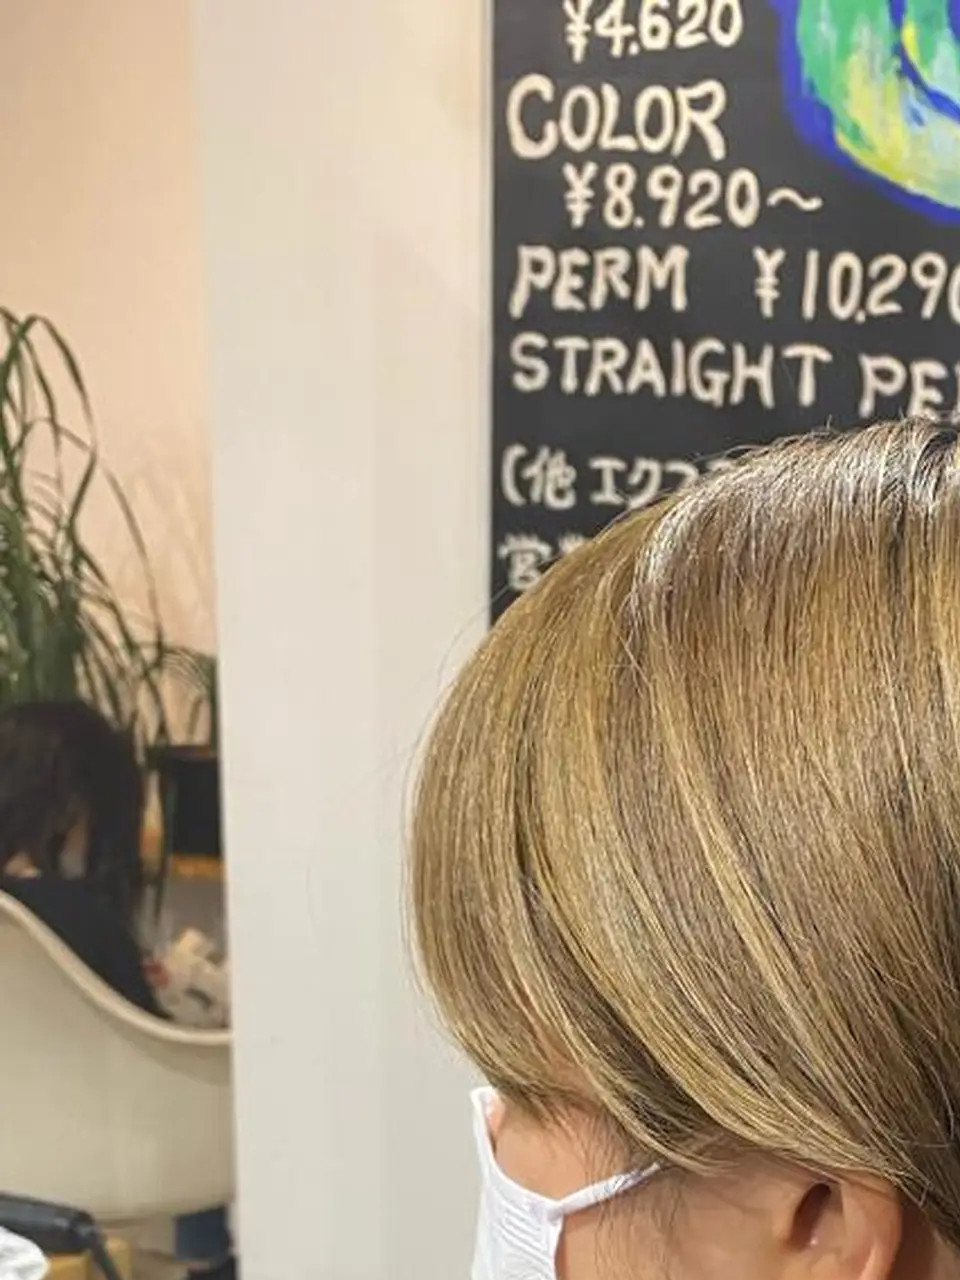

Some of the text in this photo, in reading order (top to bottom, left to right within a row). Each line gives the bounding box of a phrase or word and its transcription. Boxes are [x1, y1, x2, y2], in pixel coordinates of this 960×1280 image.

[506, 73, 727, 160] COLOR
[508, 245, 689, 319] PERM
[509, 333, 832, 408] STRAIGHT
